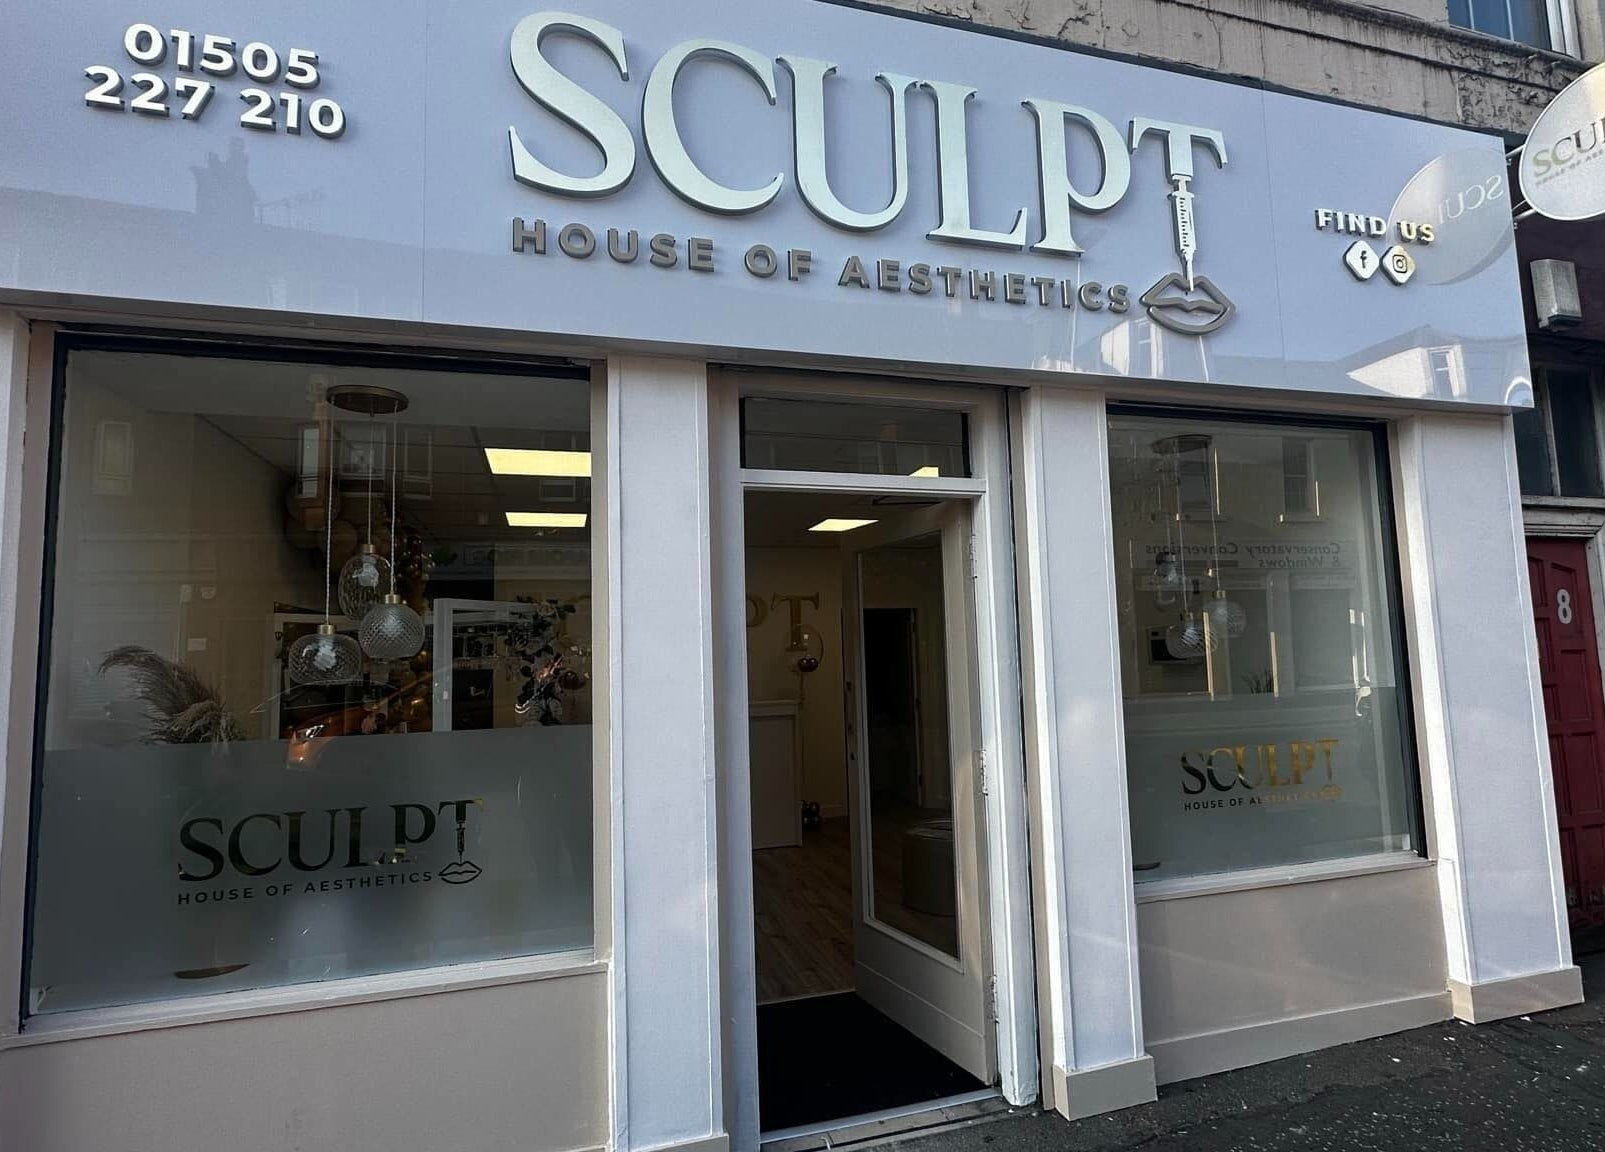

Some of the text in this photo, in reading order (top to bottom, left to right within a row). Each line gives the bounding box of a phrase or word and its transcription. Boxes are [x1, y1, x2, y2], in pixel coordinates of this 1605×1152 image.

[124, 23, 320, 89] 01505
[84, 65, 346, 139] 227 210
[509, 11, 1227, 280] SCULPT
[1533, 117, 1605, 177] SCU
[1315, 208, 1435, 245] FIND US
[512, 216, 1132, 314] HOUSE OF AESTHETICS
[1557, 589, 1572, 624] 8
[1181, 738, 1339, 795] SCULPT
[1184, 799, 1223, 811] HOUSE
[1230, 797, 1243, 807] OF
[178, 798, 483, 882] SCULPT
[177, 871, 432, 905] HOUSE OF AESTHETICS
